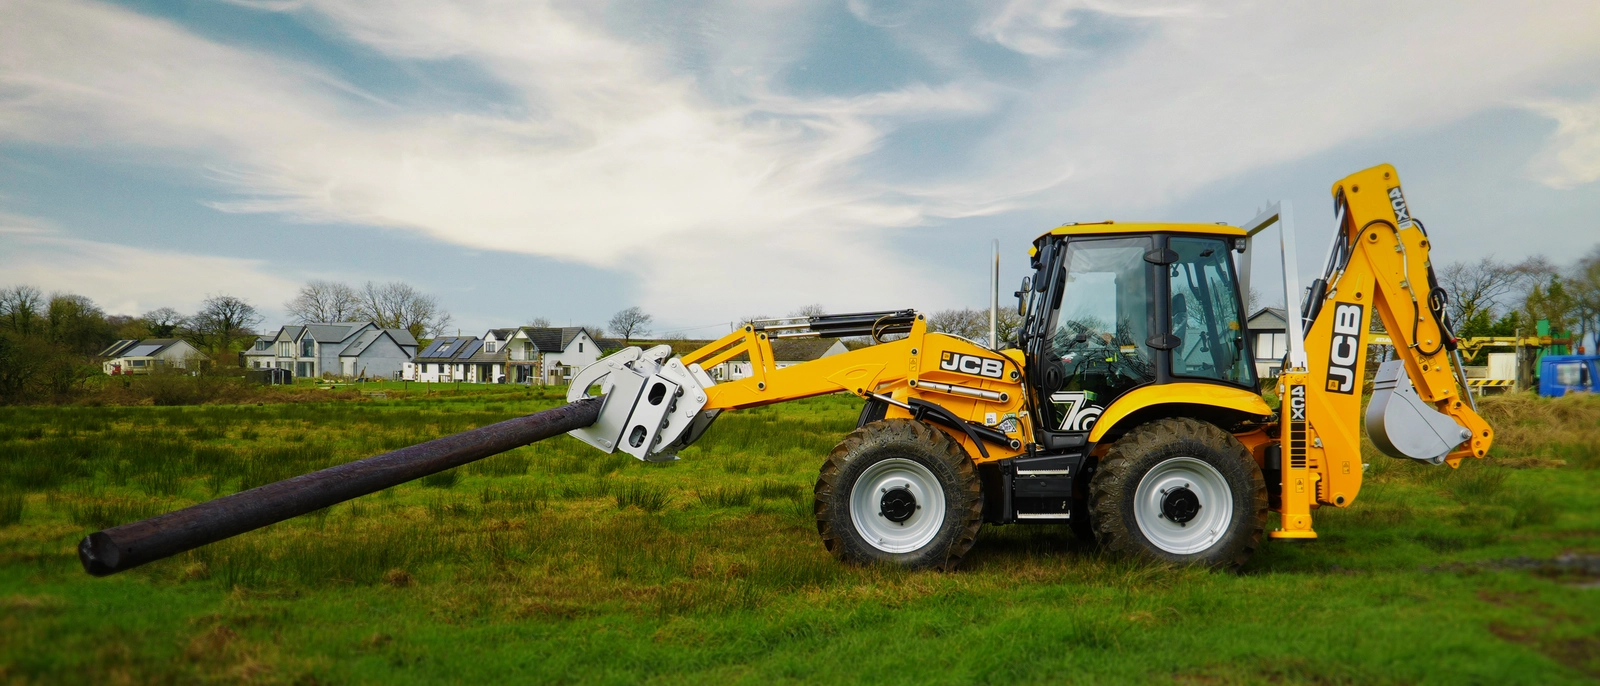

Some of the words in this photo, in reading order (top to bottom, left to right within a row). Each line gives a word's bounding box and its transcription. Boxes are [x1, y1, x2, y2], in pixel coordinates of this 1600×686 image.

[1389, 187, 1409, 221] 4CX
[1329, 304, 1361, 392] JCB
[941, 353, 1002, 378] JCB
[1291, 385, 1305, 420] 4CX
